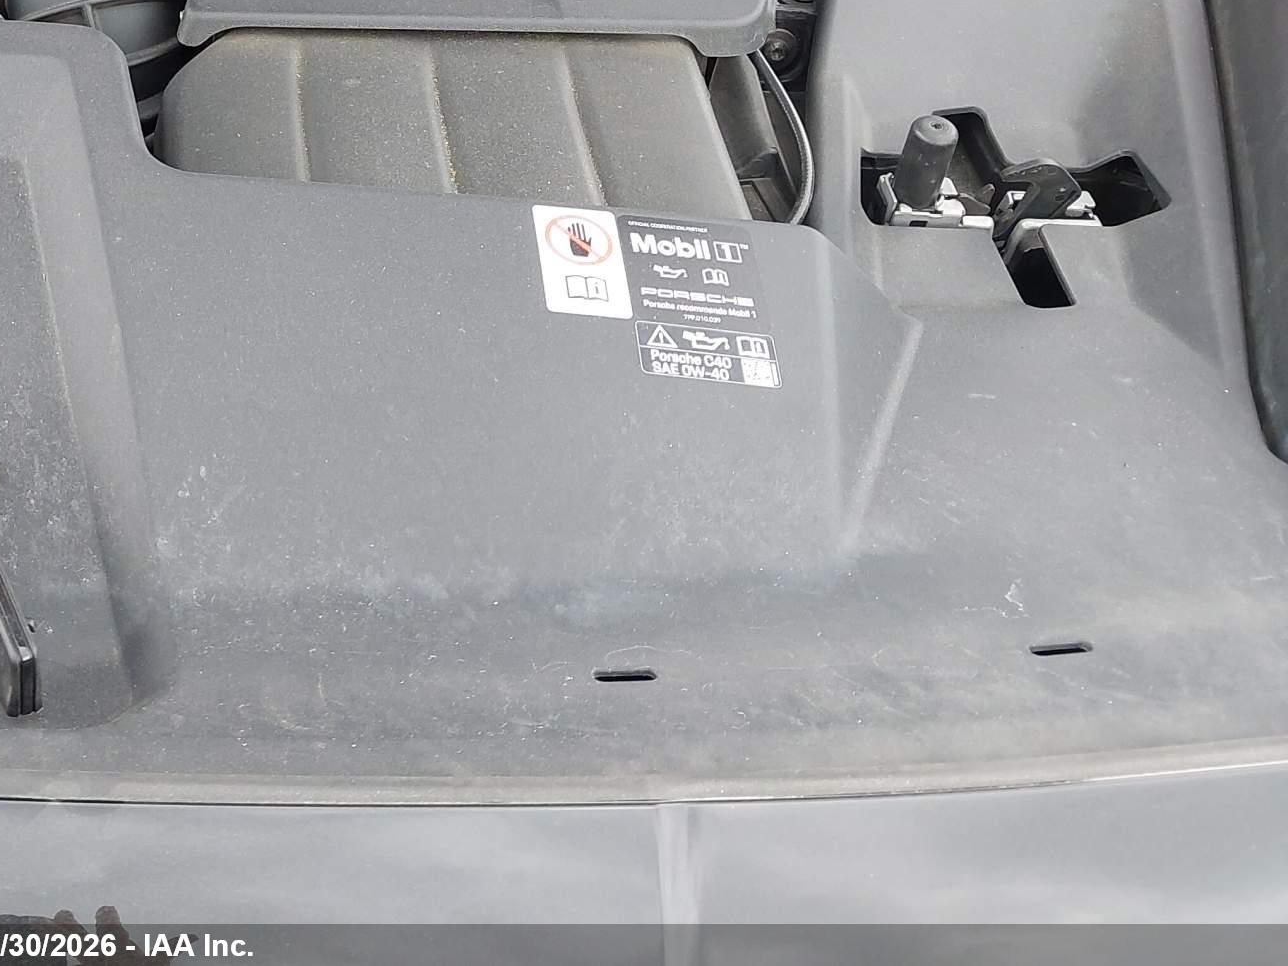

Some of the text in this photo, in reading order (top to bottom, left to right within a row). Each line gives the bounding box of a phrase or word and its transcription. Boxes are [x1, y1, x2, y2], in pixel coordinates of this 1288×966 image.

[630, 233, 711, 260] Mobil
[640, 287, 754, 307] PORSCHE
[651, 349, 732, 369] Porsche C40
[652, 361, 730, 381] SAE 0W-40
